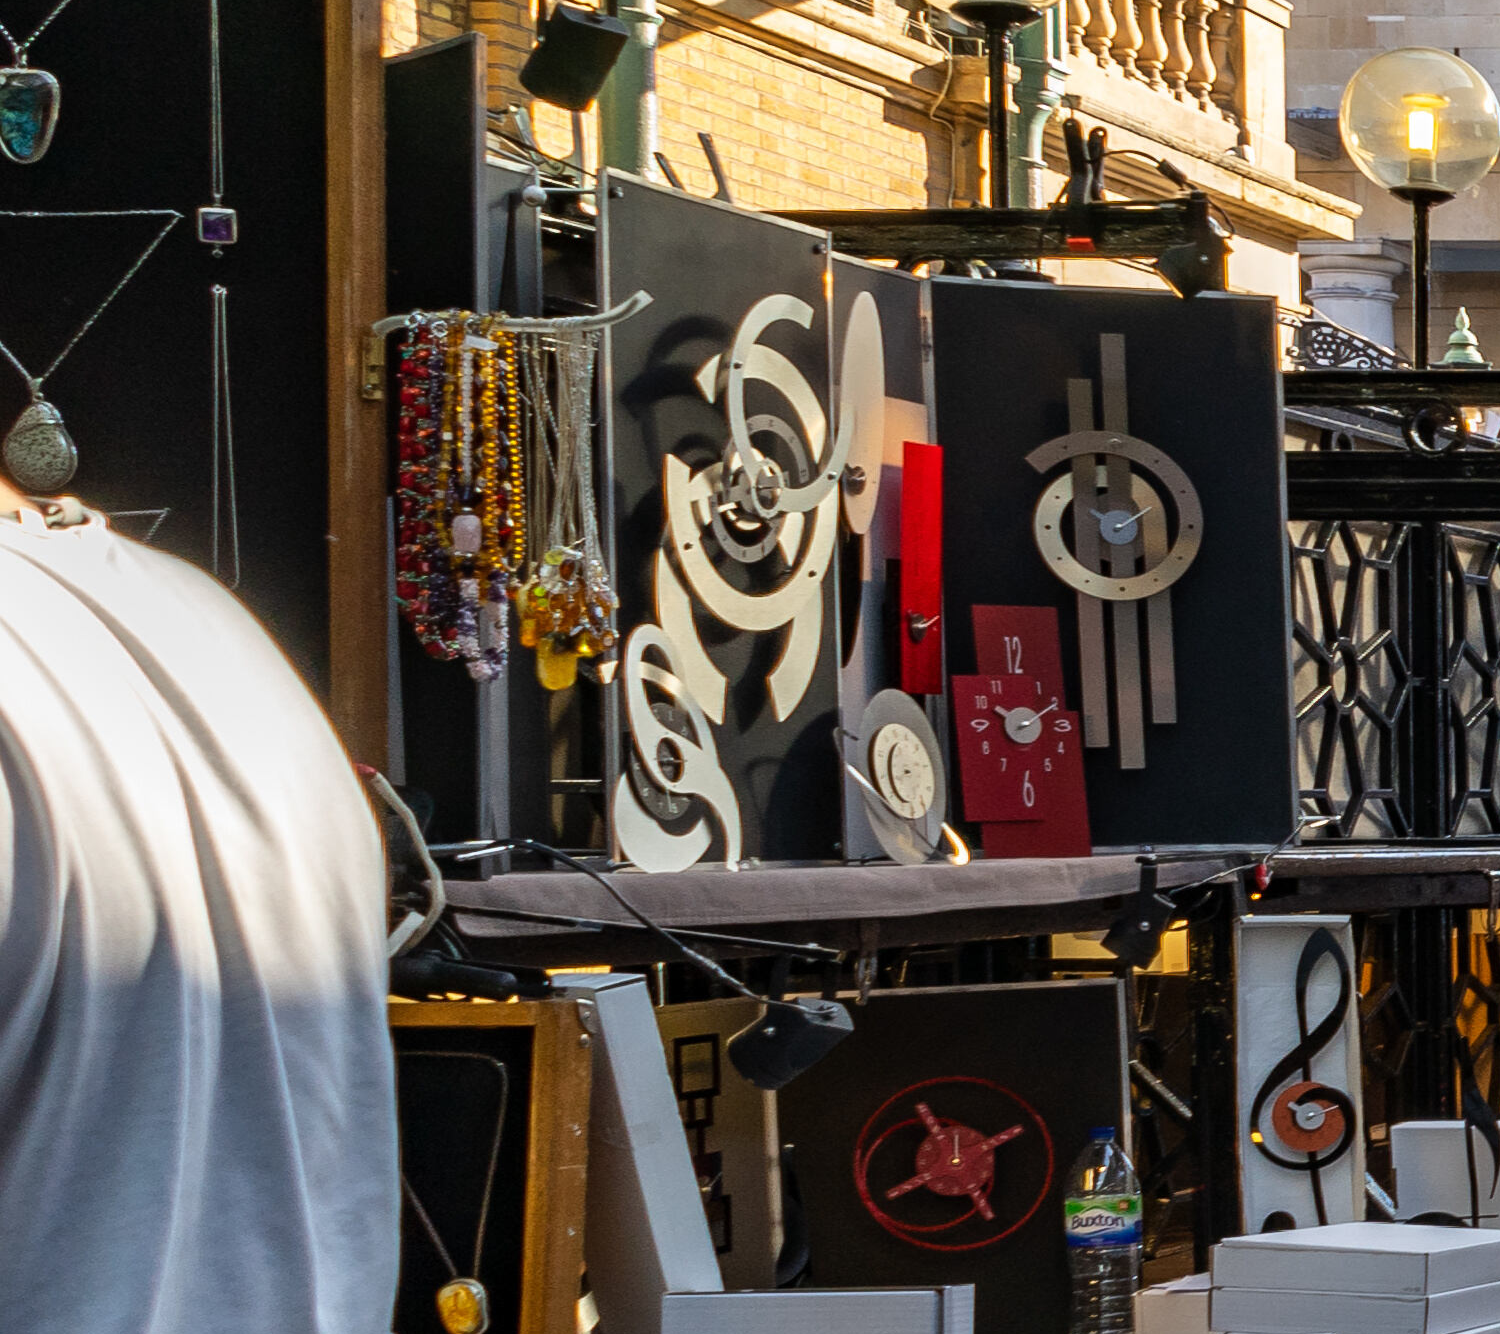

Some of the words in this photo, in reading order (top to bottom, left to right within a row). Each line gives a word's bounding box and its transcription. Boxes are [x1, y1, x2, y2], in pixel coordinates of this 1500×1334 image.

[1003, 636, 1024, 674] 12
[991, 680, 1002, 694] 11
[975, 695, 988, 709] 10
[970, 719, 990, 732] 9
[1053, 719, 1072, 732] 3
[1057, 741, 1065, 754] 4
[1000, 758, 1007, 771] 7
[1044, 758, 1052, 772] 5
[1023, 770, 1035, 808] 6
[1071, 1214, 1125, 1230] Buxton
